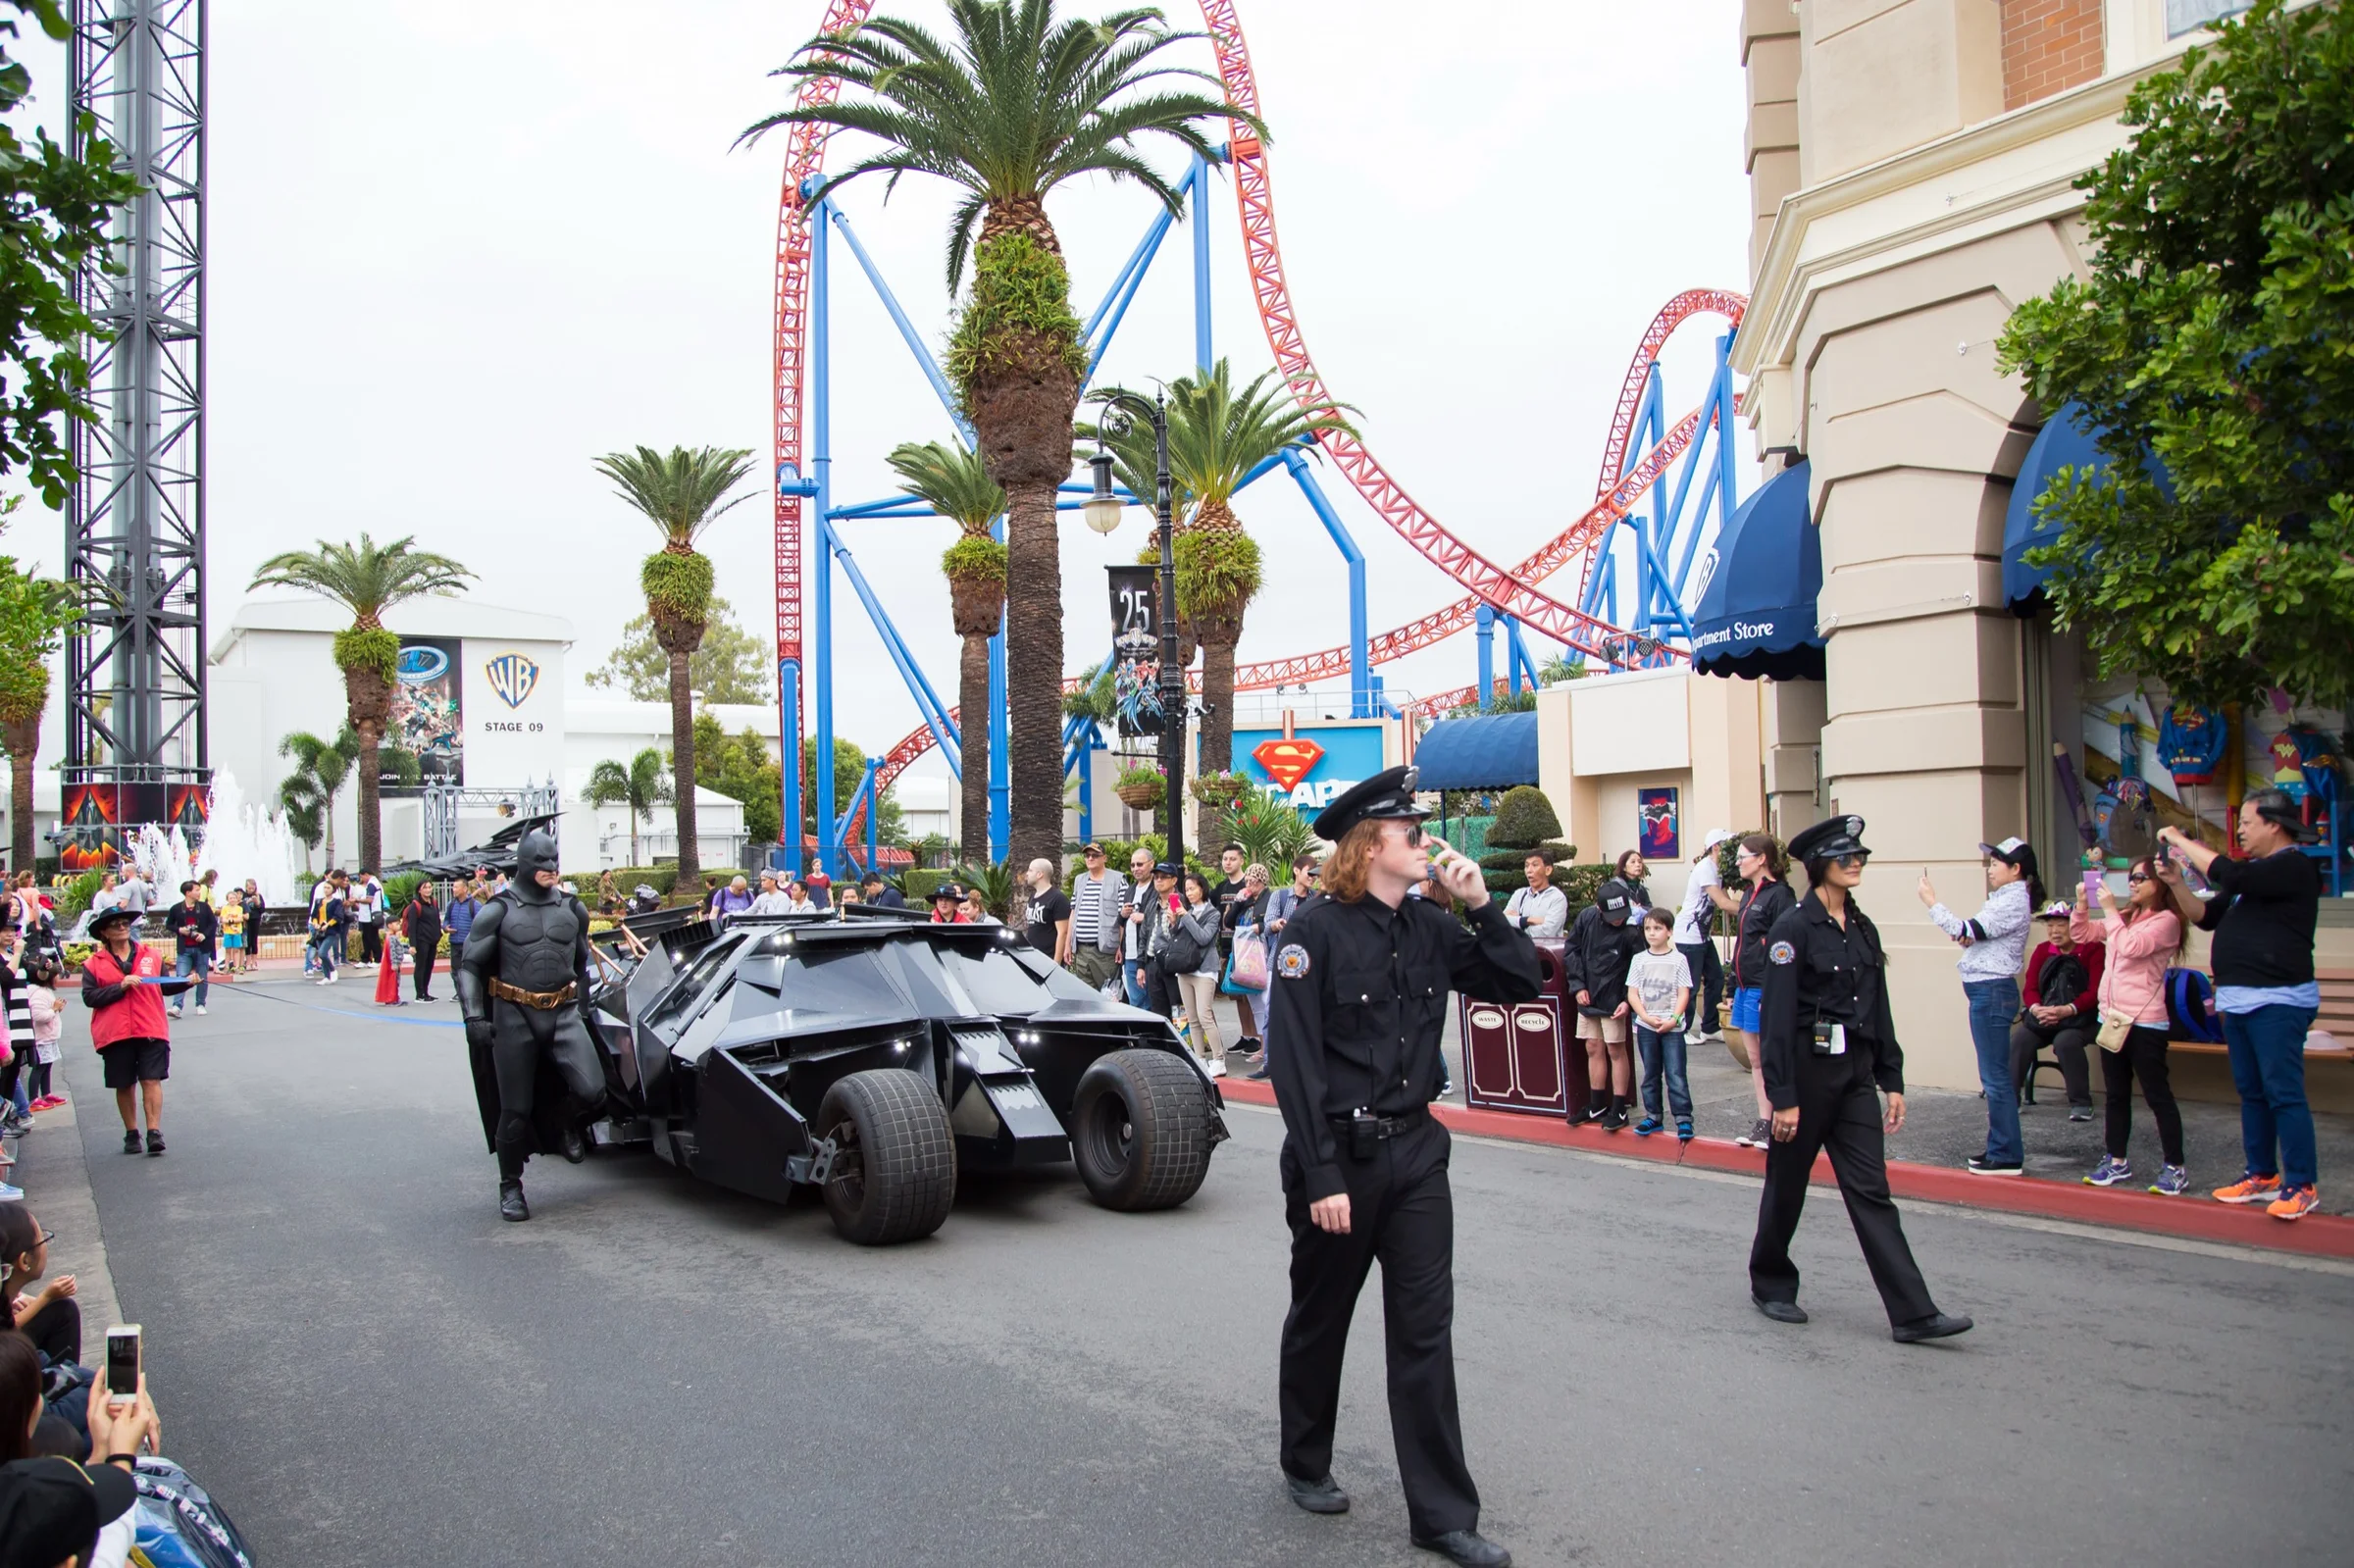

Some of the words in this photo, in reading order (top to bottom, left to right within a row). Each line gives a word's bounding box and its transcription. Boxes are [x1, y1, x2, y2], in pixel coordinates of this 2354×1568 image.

[1119, 590, 1151, 632] 25
[1692, 627, 1730, 654] partment
[1734, 621, 1774, 640] Store
[488, 655, 532, 707] WB
[485, 722, 523, 733] STAGE
[529, 722, 543, 733] 09
